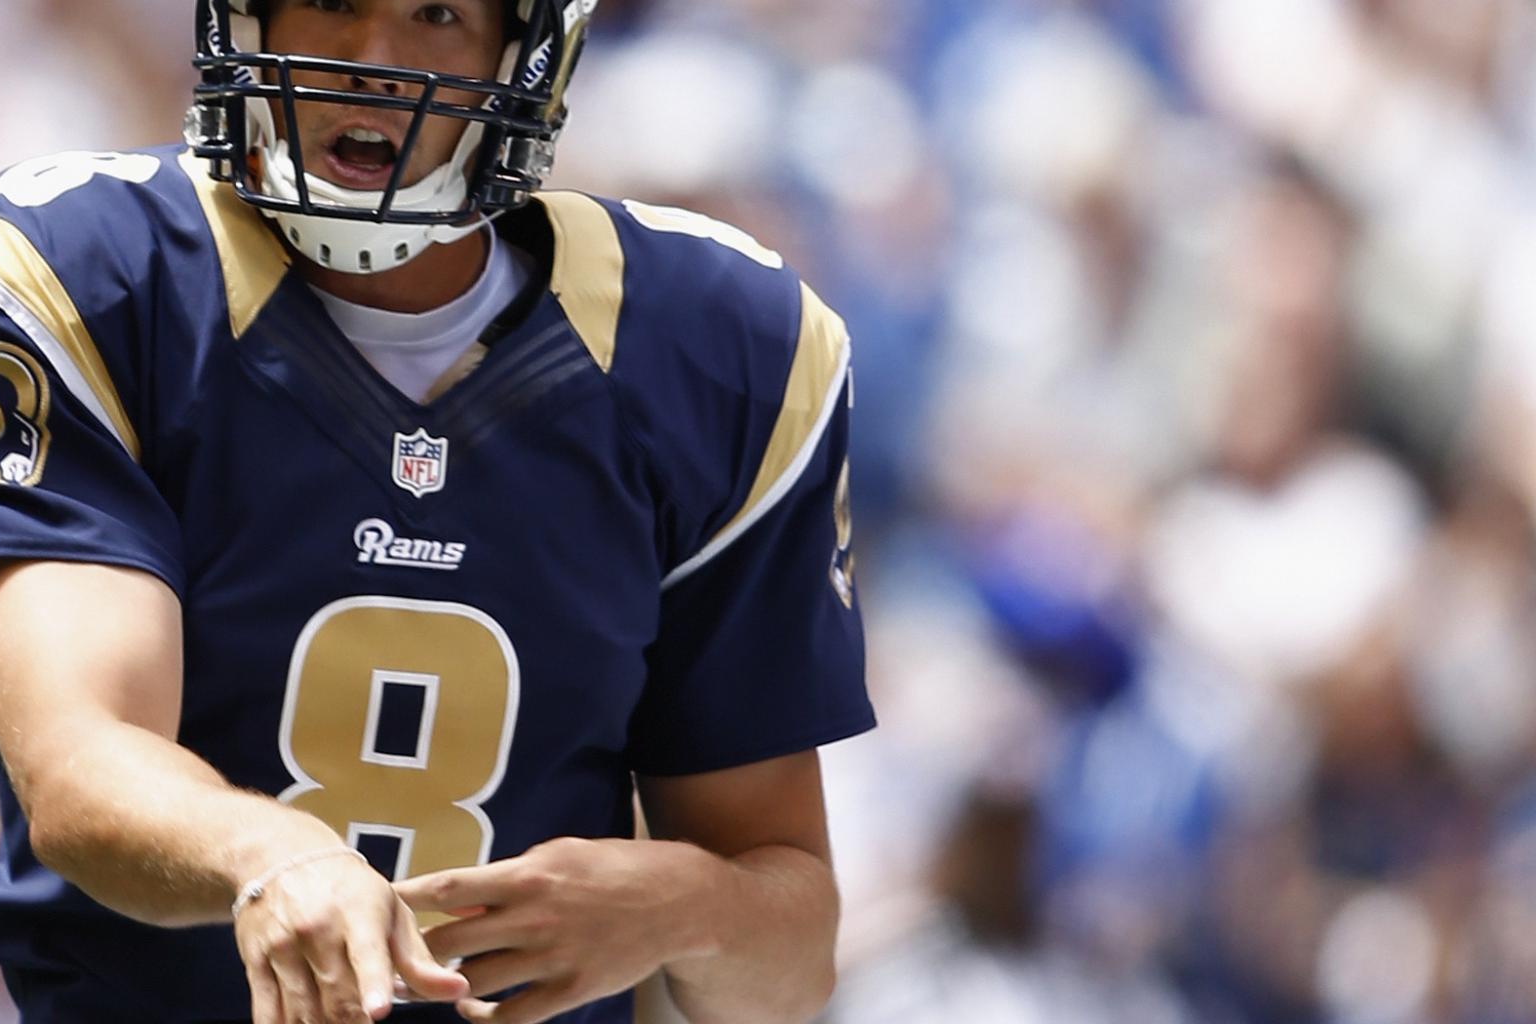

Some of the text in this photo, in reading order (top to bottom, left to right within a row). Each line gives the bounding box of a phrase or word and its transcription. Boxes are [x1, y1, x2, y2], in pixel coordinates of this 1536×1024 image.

[399, 457, 438, 484] NFL
[353, 517, 467, 570] Rams
[279, 595, 520, 931] 8
